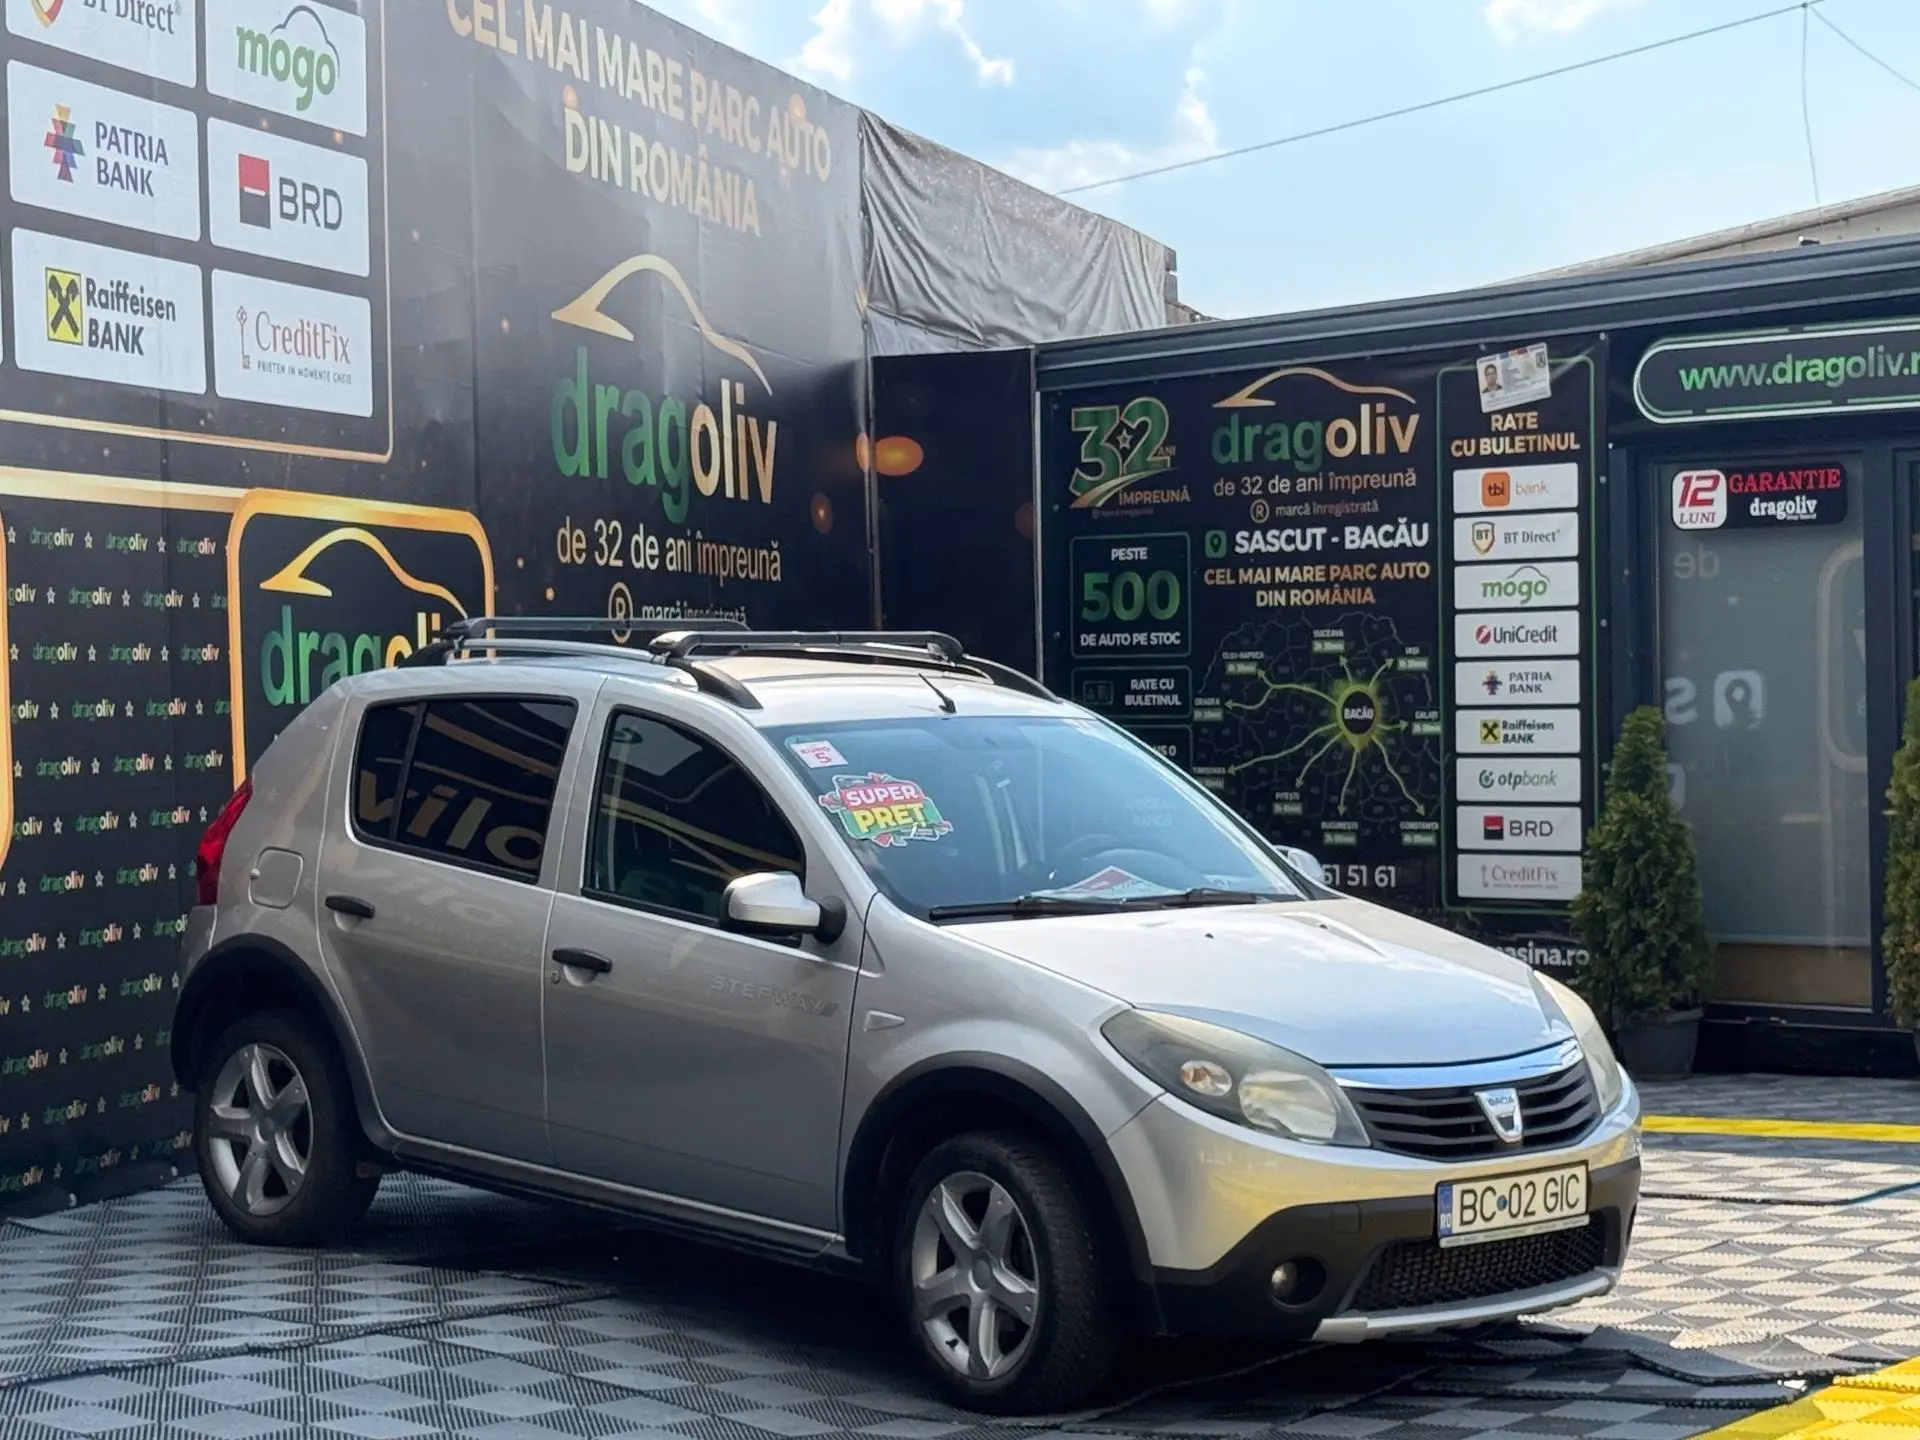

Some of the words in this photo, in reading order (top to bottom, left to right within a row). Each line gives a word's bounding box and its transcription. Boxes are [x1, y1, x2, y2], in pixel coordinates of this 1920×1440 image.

[236, 25, 337, 111] mogo
[446, 0, 518, 54] CEL
[523, 0, 590, 83] MAI
[597, 27, 685, 121] MARE
[689, 68, 761, 153] PARC
[766, 105, 831, 183] AUTO
[95, 120, 169, 166] PATRIA
[96, 157, 155, 197] BANK
[564, 108, 622, 188] DIN
[629, 131, 761, 237] ROMÂNIA
[279, 176, 343, 230] BRD
[86, 277, 176, 322] Raiffeisen
[88, 318, 145, 356] BANK
[255, 311, 351, 364] CreditFix
[1490, 411, 1539, 432] RATE
[552, 346, 778, 524] dragoliv
[1069, 396, 1170, 496] 32
[1212, 402, 1420, 472] dragoliv
[1450, 439, 1476, 457] CU
[1480, 432, 1581, 456] BULETINUL
[1213, 479, 1235, 497] de
[1240, 477, 1263, 496] 32
[1268, 475, 1290, 494] de
[1295, 472, 1324, 492] ani
[1329, 468, 1417, 494] împreună
[1487, 482, 1506, 497] tbi
[1515, 480, 1549, 496] bank
[1678, 474, 1721, 508] 12
[1728, 468, 1842, 493] GARANTIE
[1275, 503, 1311, 517] marcă
[1679, 512, 1717, 525] LUNI
[1750, 495, 1818, 520] dragoliv
[1235, 528, 1327, 554] SASCUT
[1344, 517, 1430, 550] BACĂU
[1503, 531, 1520, 544] BT
[1522, 529, 1557, 544] Direct
[557, 516, 587, 565] de
[594, 518, 624, 567] 32
[630, 523, 660, 571] de
[665, 530, 692, 573] ani
[696, 531, 782, 587] împreună
[1111, 547, 1148, 561] PESTE
[1204, 569, 1237, 586] CEL
[1239, 567, 1271, 584] MAI
[1275, 565, 1326, 583] MARE
[1329, 563, 1377, 581] PARC
[1380, 561, 1430, 579] AUTO
[1081, 570, 1181, 622] 500
[1256, 590, 1286, 607] DIN
[1289, 583, 1375, 606] ROMÂNIA
[1481, 578, 1549, 607] mogo
[1080, 633, 1098, 648] DE
[1098, 632, 1132, 647] AUTO
[1132, 632, 1148, 646] PE
[1149, 631, 1181, 646] STOC
[1493, 624, 1558, 644] UniCredit
[1130, 678, 1158, 691] RATE
[1159, 678, 1175, 690] CU
[1509, 671, 1552, 682] PATRIA
[1509, 682, 1543, 694] BANK
[1124, 694, 1182, 706] BULETINUL
[1502, 718, 1555, 731] Raiffeisen
[1502, 732, 1535, 745] BANK
[1497, 769, 1557, 792] otpbank
[846, 785, 919, 806] SUPER
[1509, 820, 1554, 837] BRD
[1347, 864, 1367, 887] 51
[1374, 865, 1396, 888] 61
[711, 975, 823, 1012] STEPWAY
[1460, 1186, 1497, 1226] BC
[1508, 1180, 1537, 1218] 02
[1543, 1173, 1580, 1213] GIC
